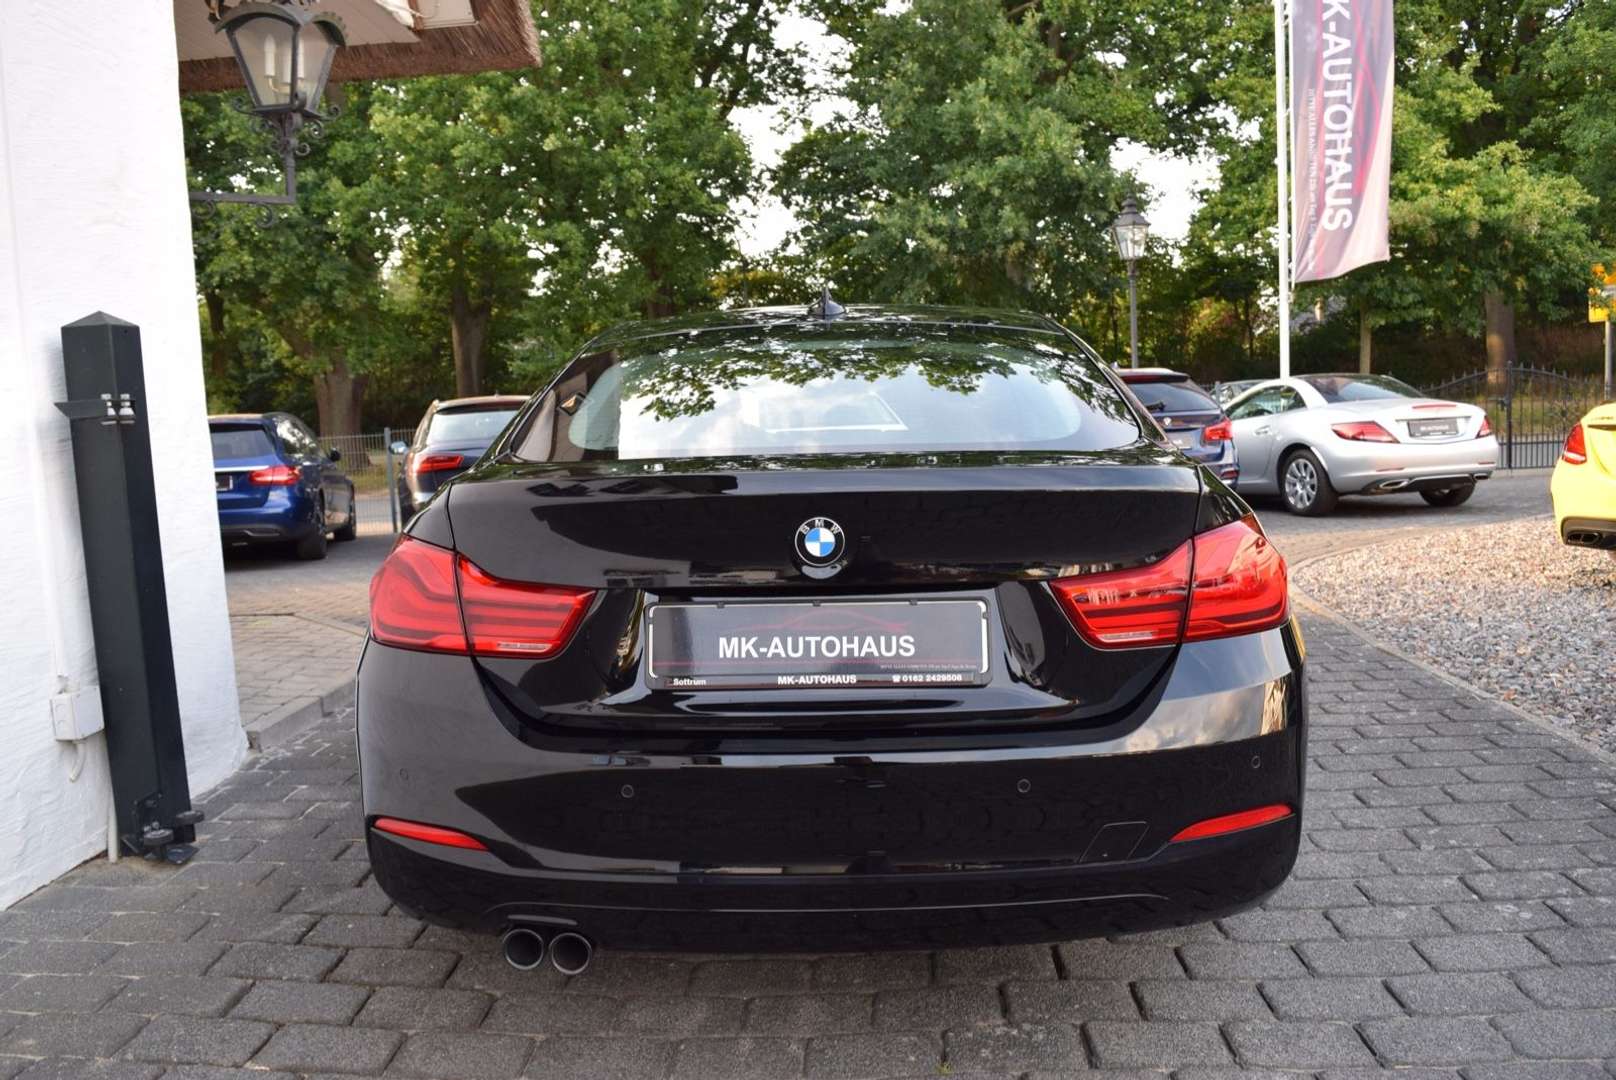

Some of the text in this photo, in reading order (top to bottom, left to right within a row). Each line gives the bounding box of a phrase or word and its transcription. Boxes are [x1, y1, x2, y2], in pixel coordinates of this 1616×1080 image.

[799, 518, 841, 535] BMW
[718, 635, 916, 659] MK-AUTOHAUS
[673, 678, 707, 687] Sottrum
[777, 674, 857, 685] MK-AUTOHAUS
